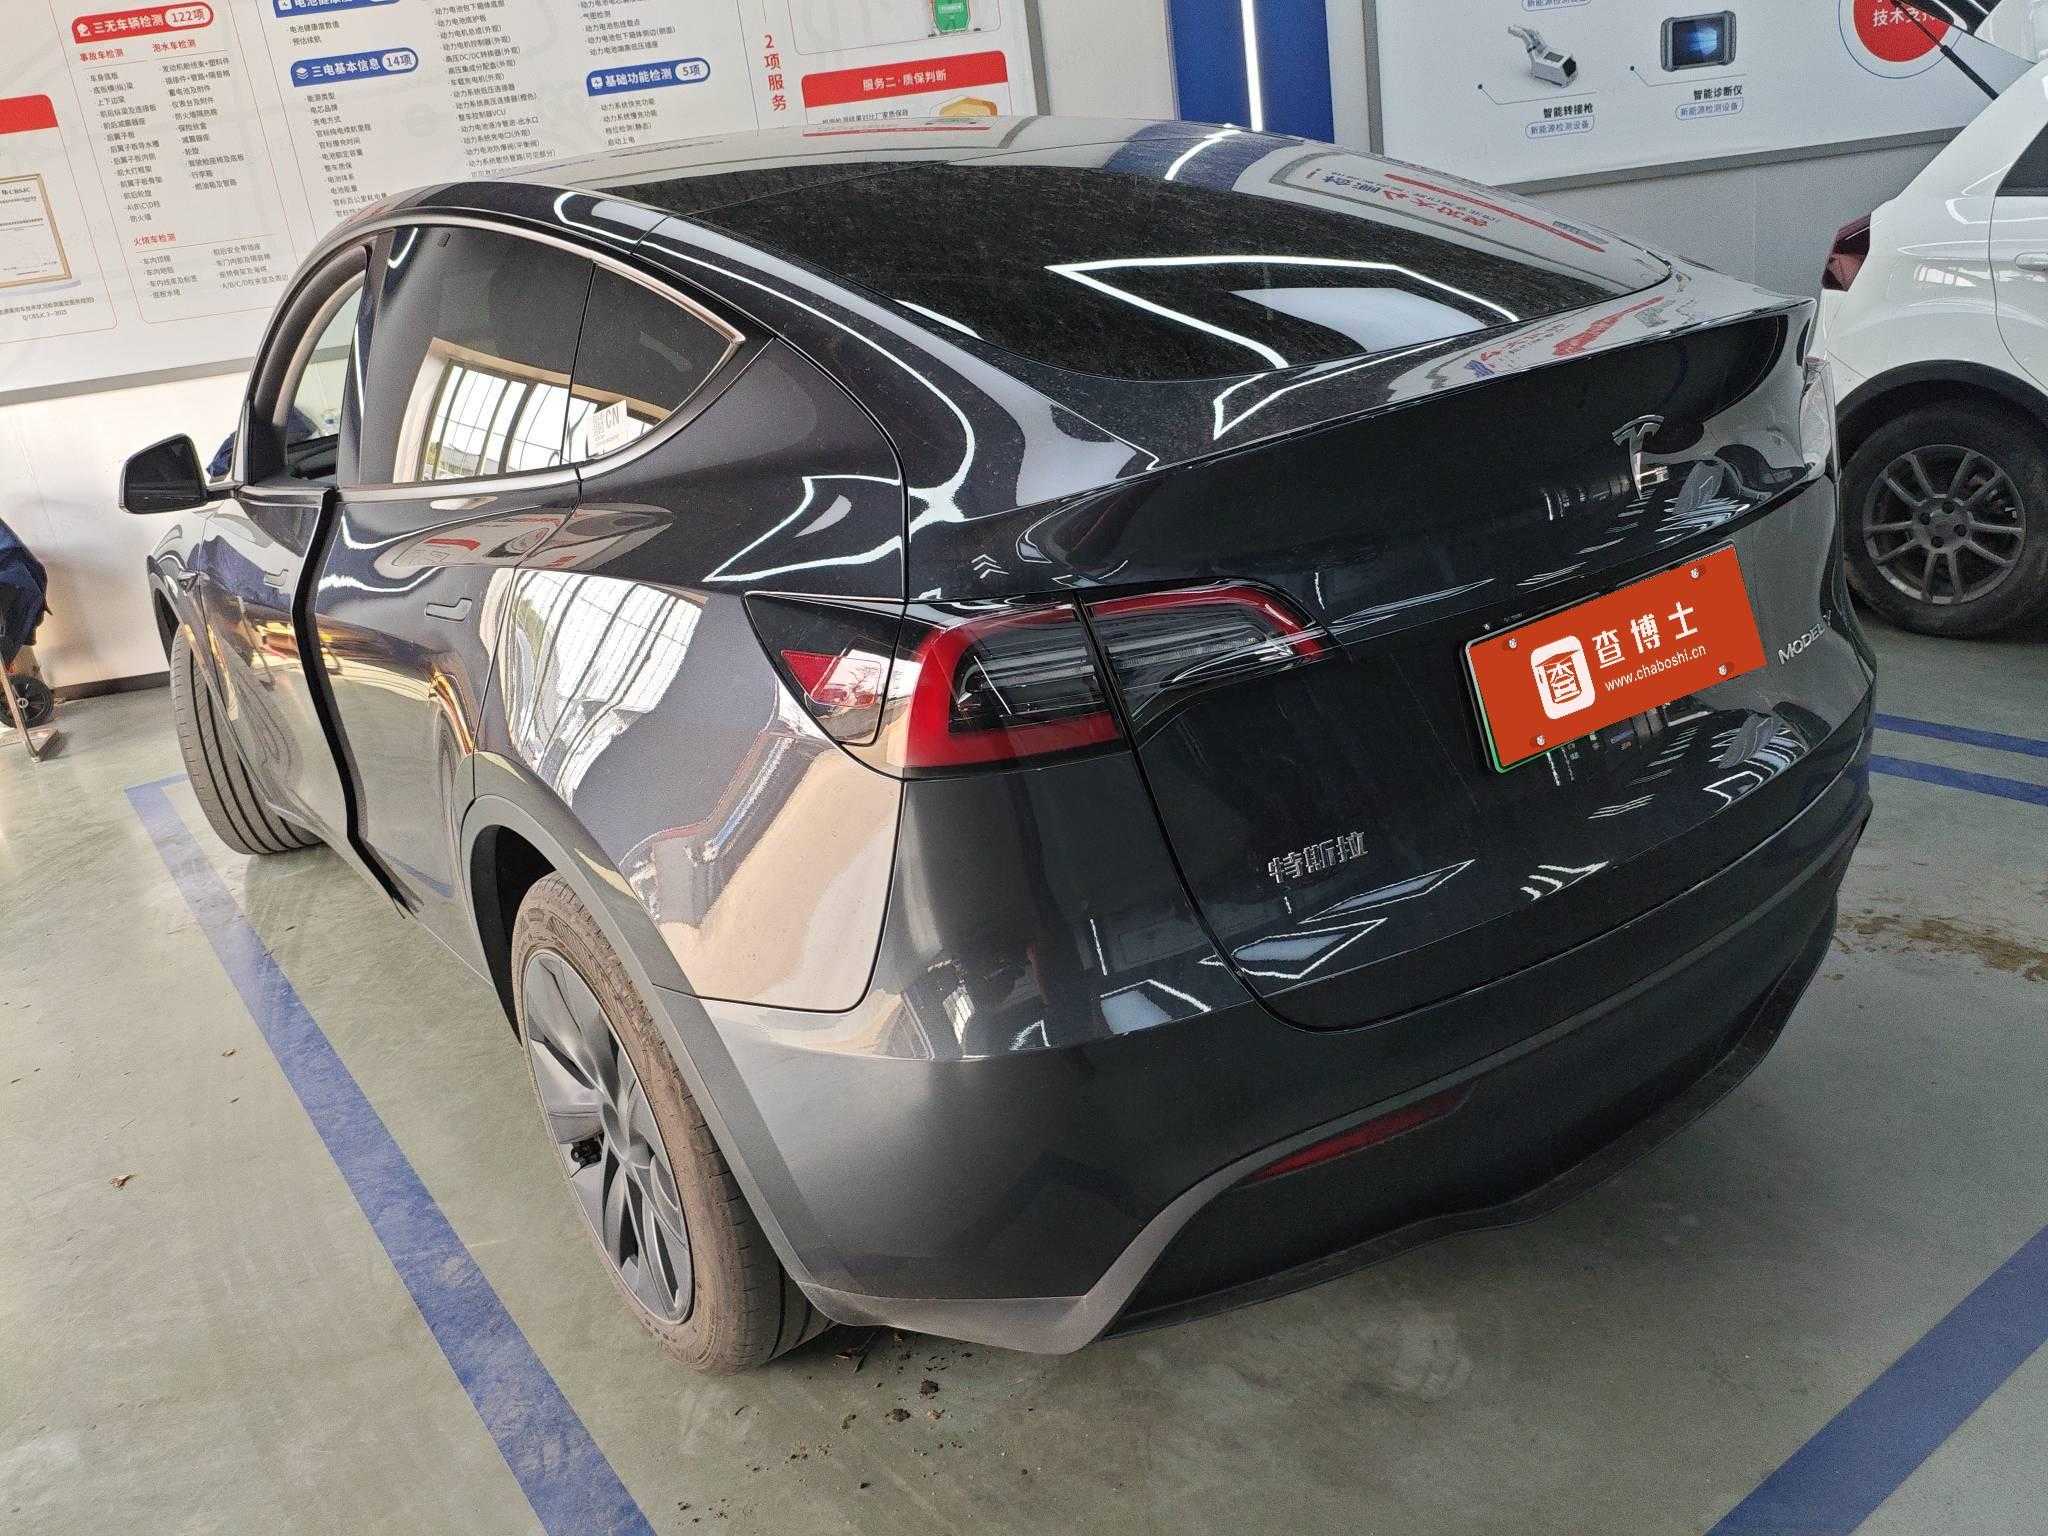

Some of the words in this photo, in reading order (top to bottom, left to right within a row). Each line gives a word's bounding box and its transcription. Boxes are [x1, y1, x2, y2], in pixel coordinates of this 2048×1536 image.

[93, 14, 163, 33] 三无车辆检测
[172, 9, 205, 23] 122项
[80, 48, 124, 62] 事故车检测
[152, 39, 196, 52] 泡水车检测
[312, 58, 381, 77] 三电基本信息
[386, 52, 412, 67] 14项
[764, 34, 787, 112] 2项服务
[606, 68, 672, 87] 基础功能检测
[682, 65, 700, 76] 5项
[1693, 85, 1743, 100] 智能诊断仪
[1543, 104, 1593, 118] 智能转接枪
[1680, 103, 1739, 116] 新能源检测设备
[1530, 121, 1590, 137] 新能源检测设备
[1778, 623, 1826, 665] MODEL
[1267, 831, 1368, 884] 特斯拉
